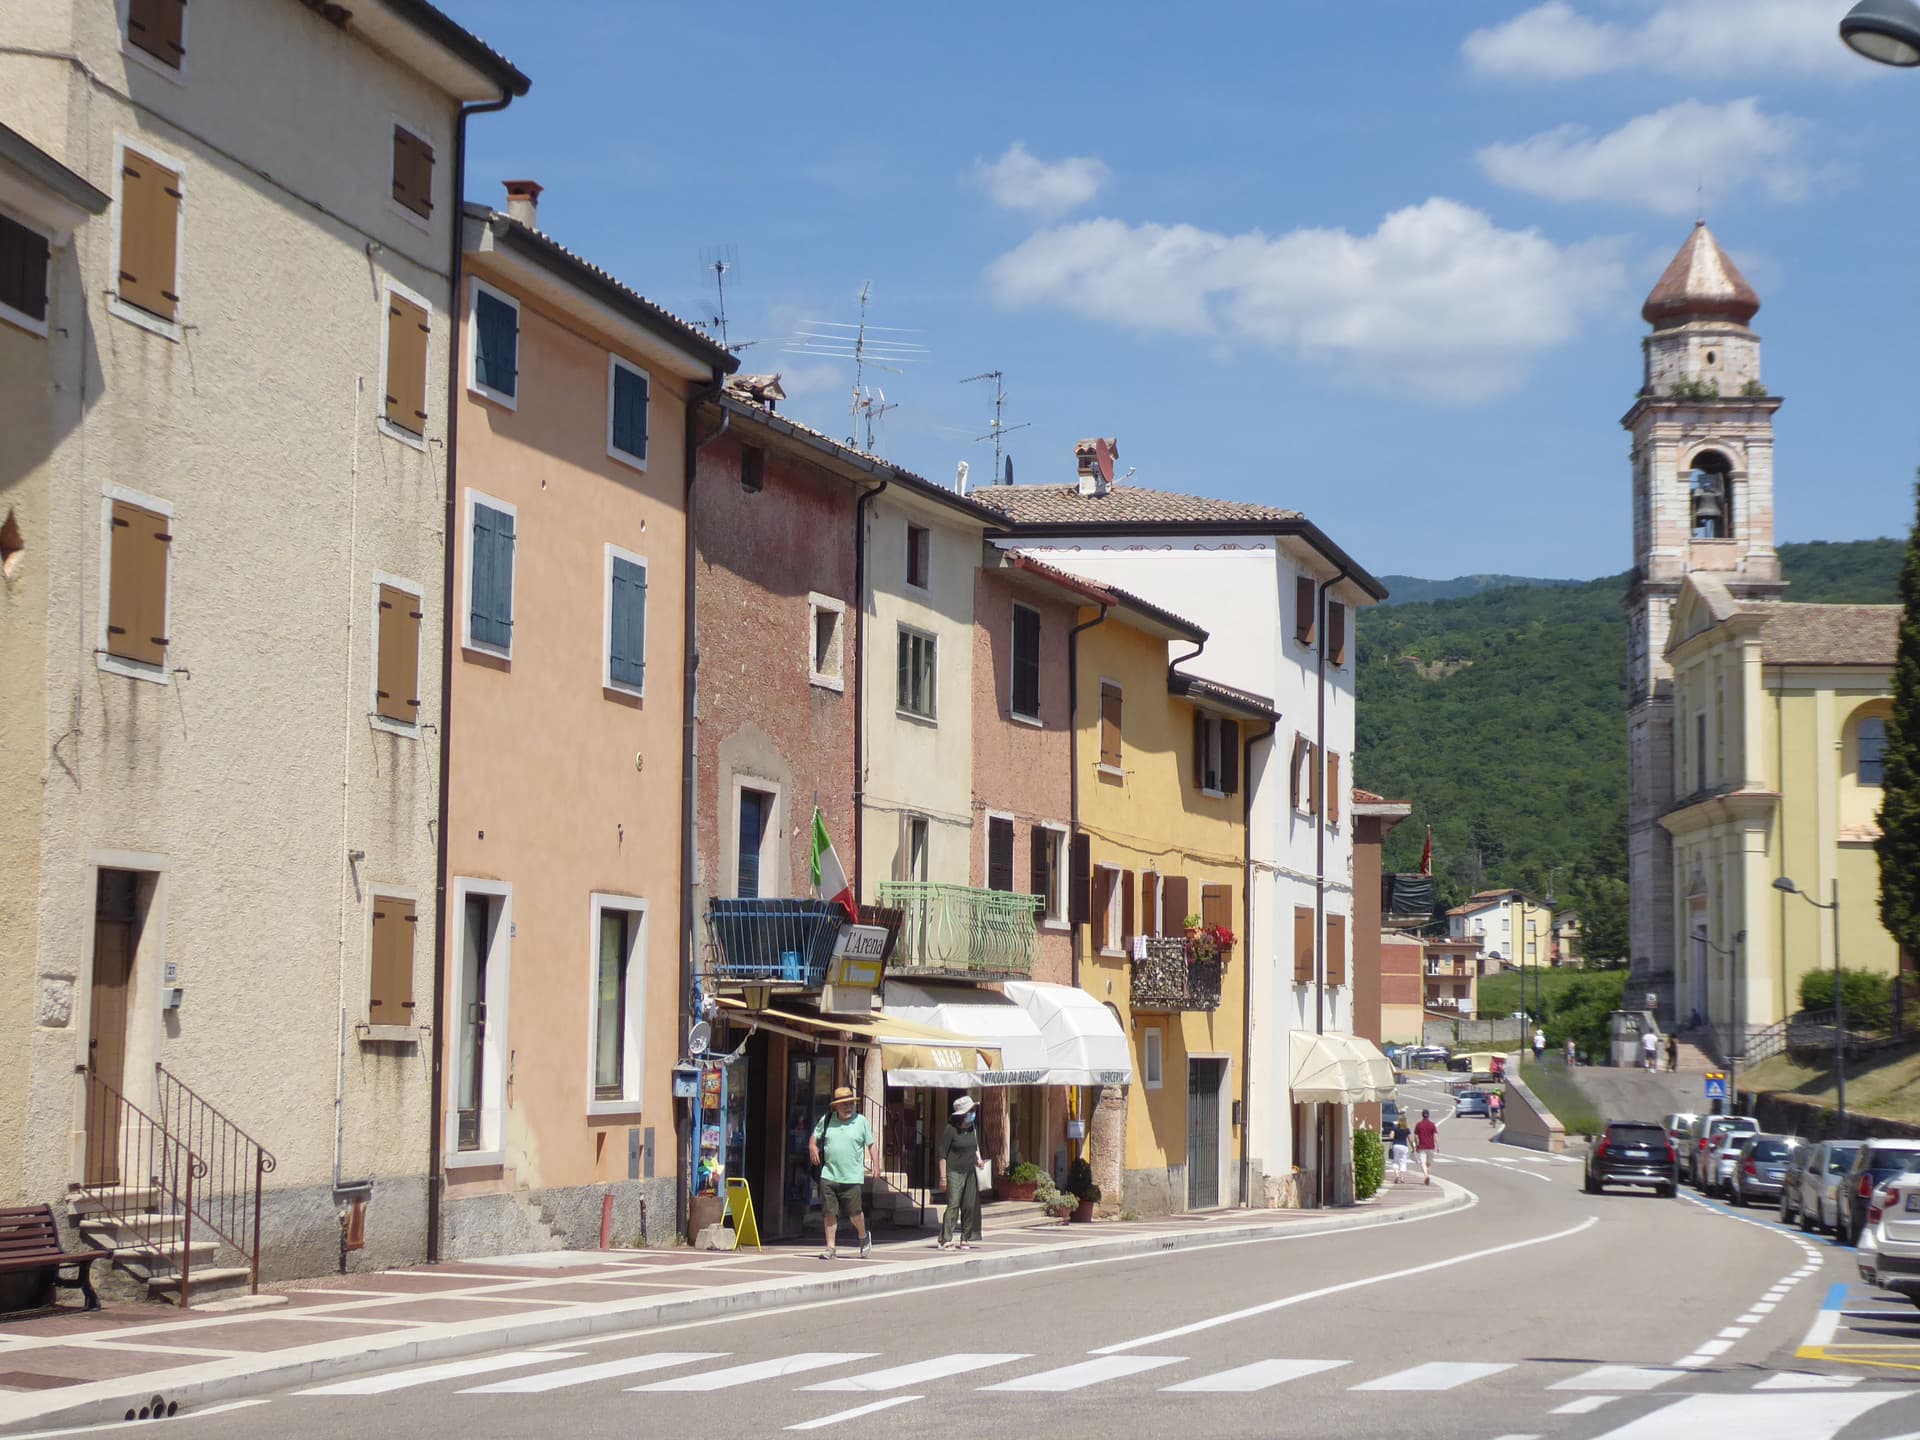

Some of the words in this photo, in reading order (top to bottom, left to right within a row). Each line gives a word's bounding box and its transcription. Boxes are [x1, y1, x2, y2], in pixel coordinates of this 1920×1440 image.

[845, 931, 883, 954] L'Arena
[981, 1071, 1007, 1084] ARTICOLI
[1008, 1071, 1017, 1083] DA
[1018, 1070, 1040, 1083] REGALO
